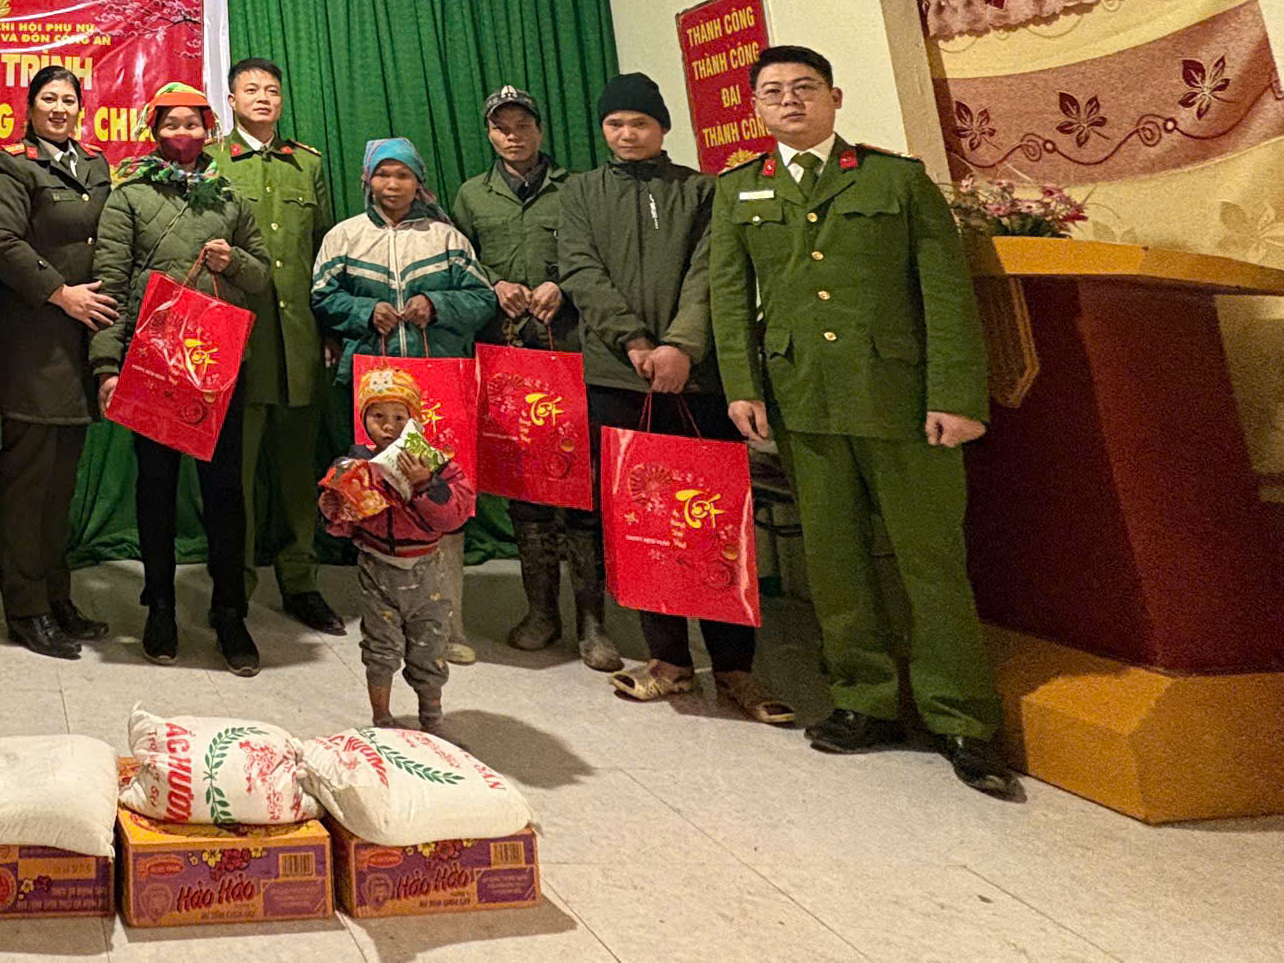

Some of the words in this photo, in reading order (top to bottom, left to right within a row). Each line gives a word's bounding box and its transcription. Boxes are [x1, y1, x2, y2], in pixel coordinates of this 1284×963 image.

[93, 35, 112, 46] AN
[687, 16, 722, 48] THÀNH
[724, 5, 756, 36] CÔNG
[692, 51, 728, 81] THÀNH
[729, 40, 760, 70] CÔNG
[721, 84, 741, 112] ĐẠI
[702, 119, 740, 149] THÀNH
